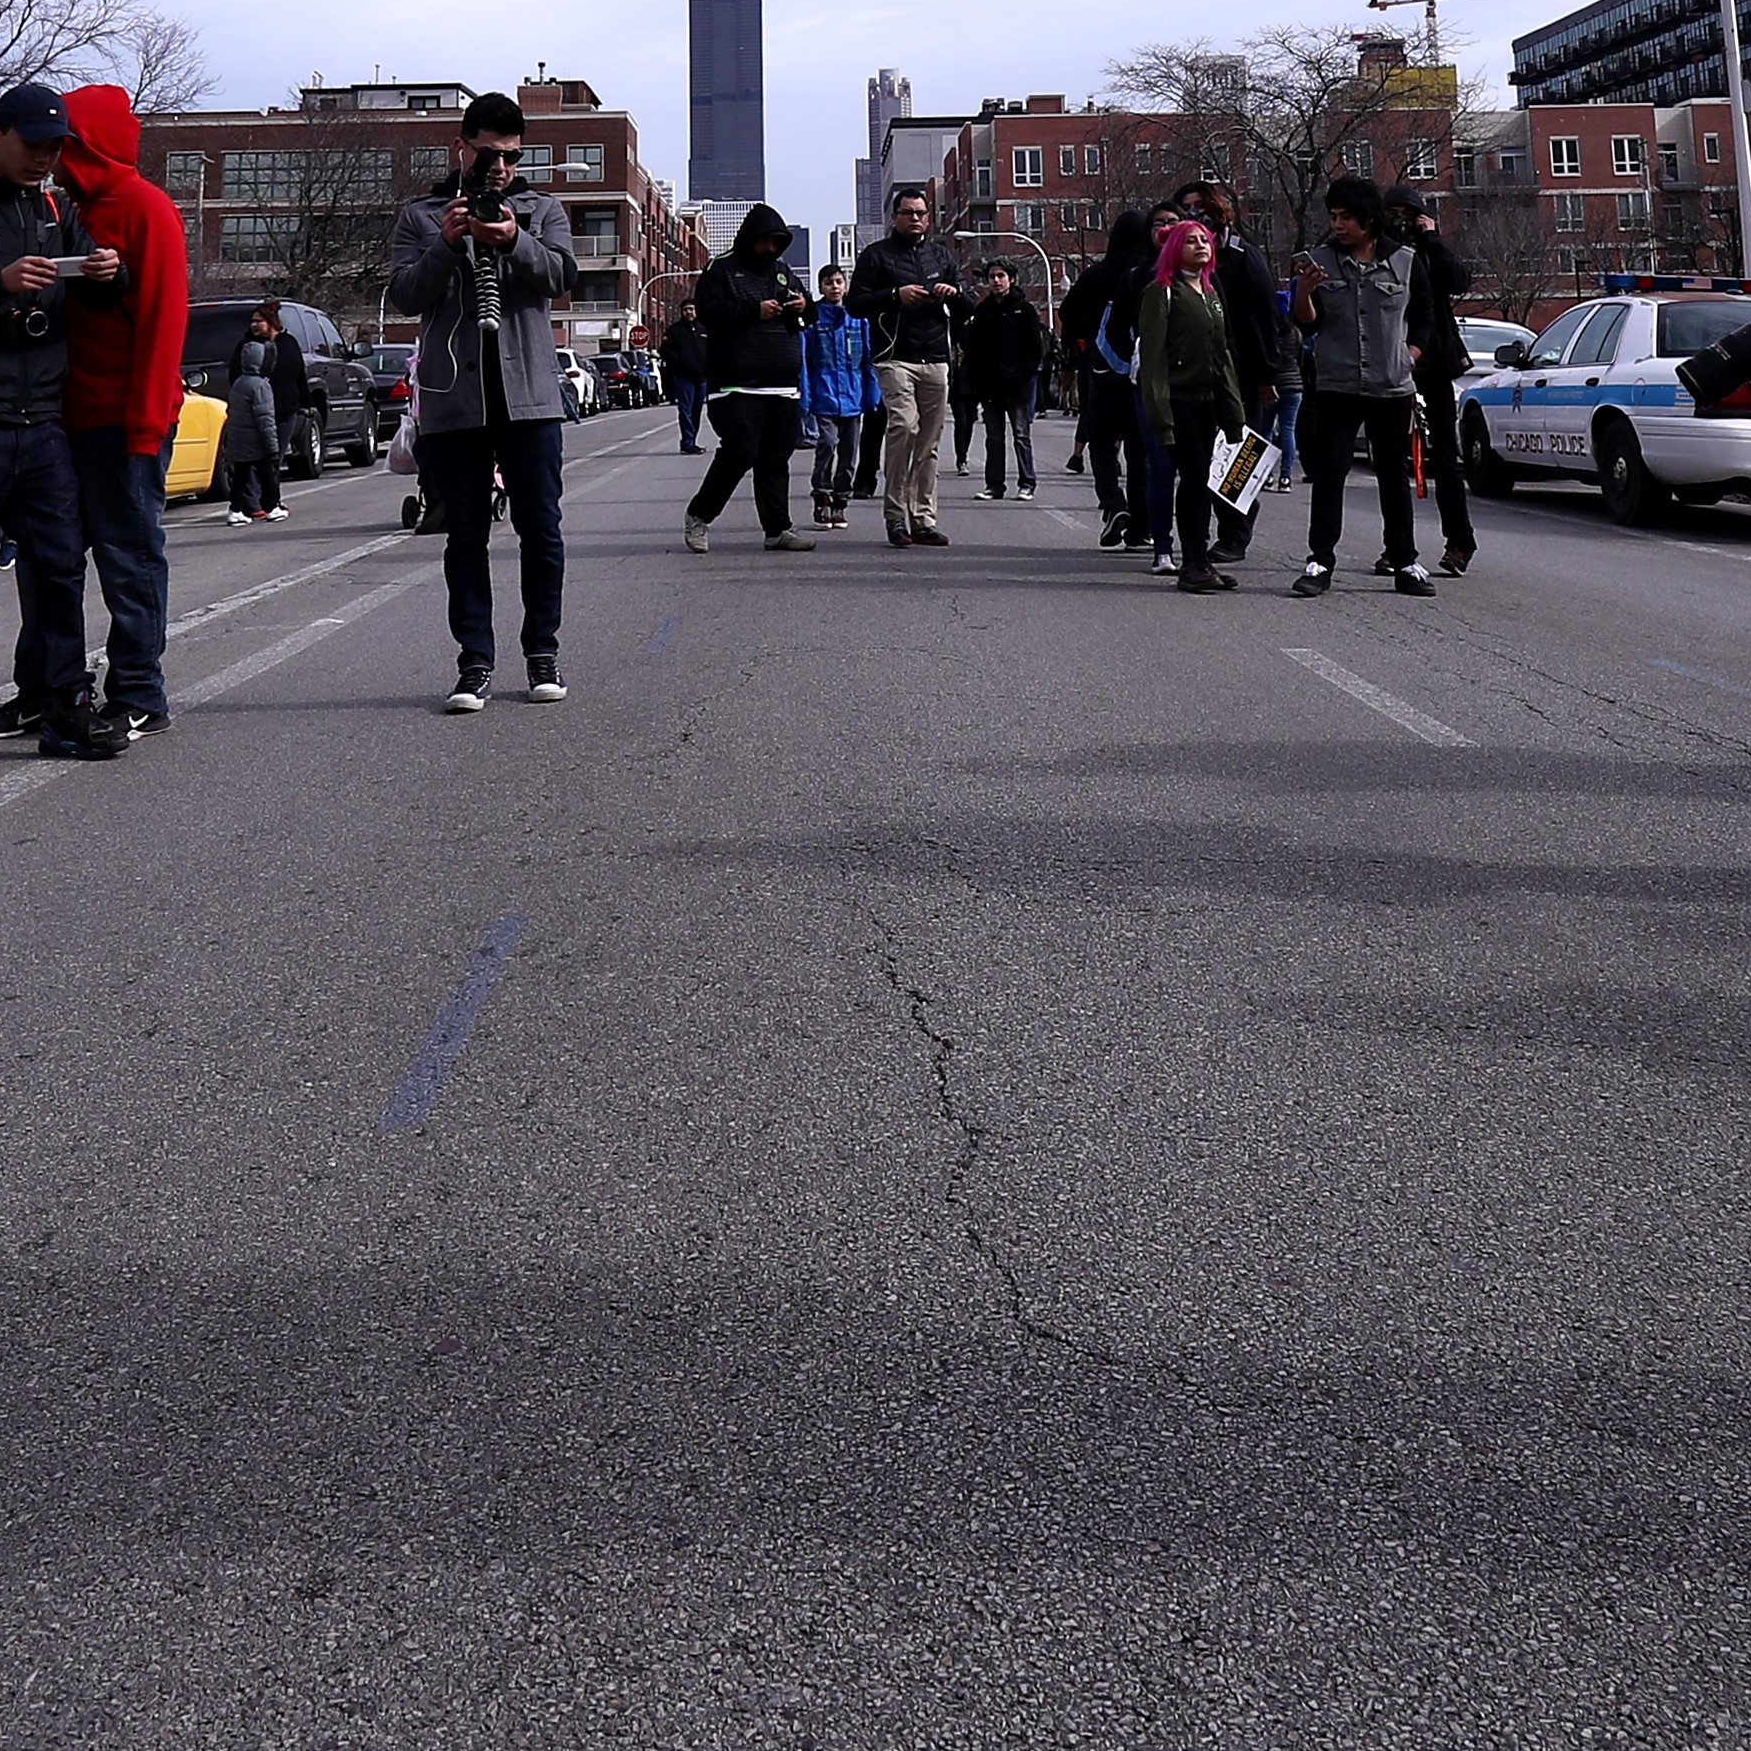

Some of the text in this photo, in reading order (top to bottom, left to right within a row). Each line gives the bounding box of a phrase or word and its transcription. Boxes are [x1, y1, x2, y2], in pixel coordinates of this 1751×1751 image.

[630, 331, 649, 341] STOP
[1505, 433, 1587, 457] CHICAGO POLICE
[1227, 458, 1244, 483] HUMAN
[1240, 436, 1257, 459] BEING
[1232, 479, 1243, 490] IS
